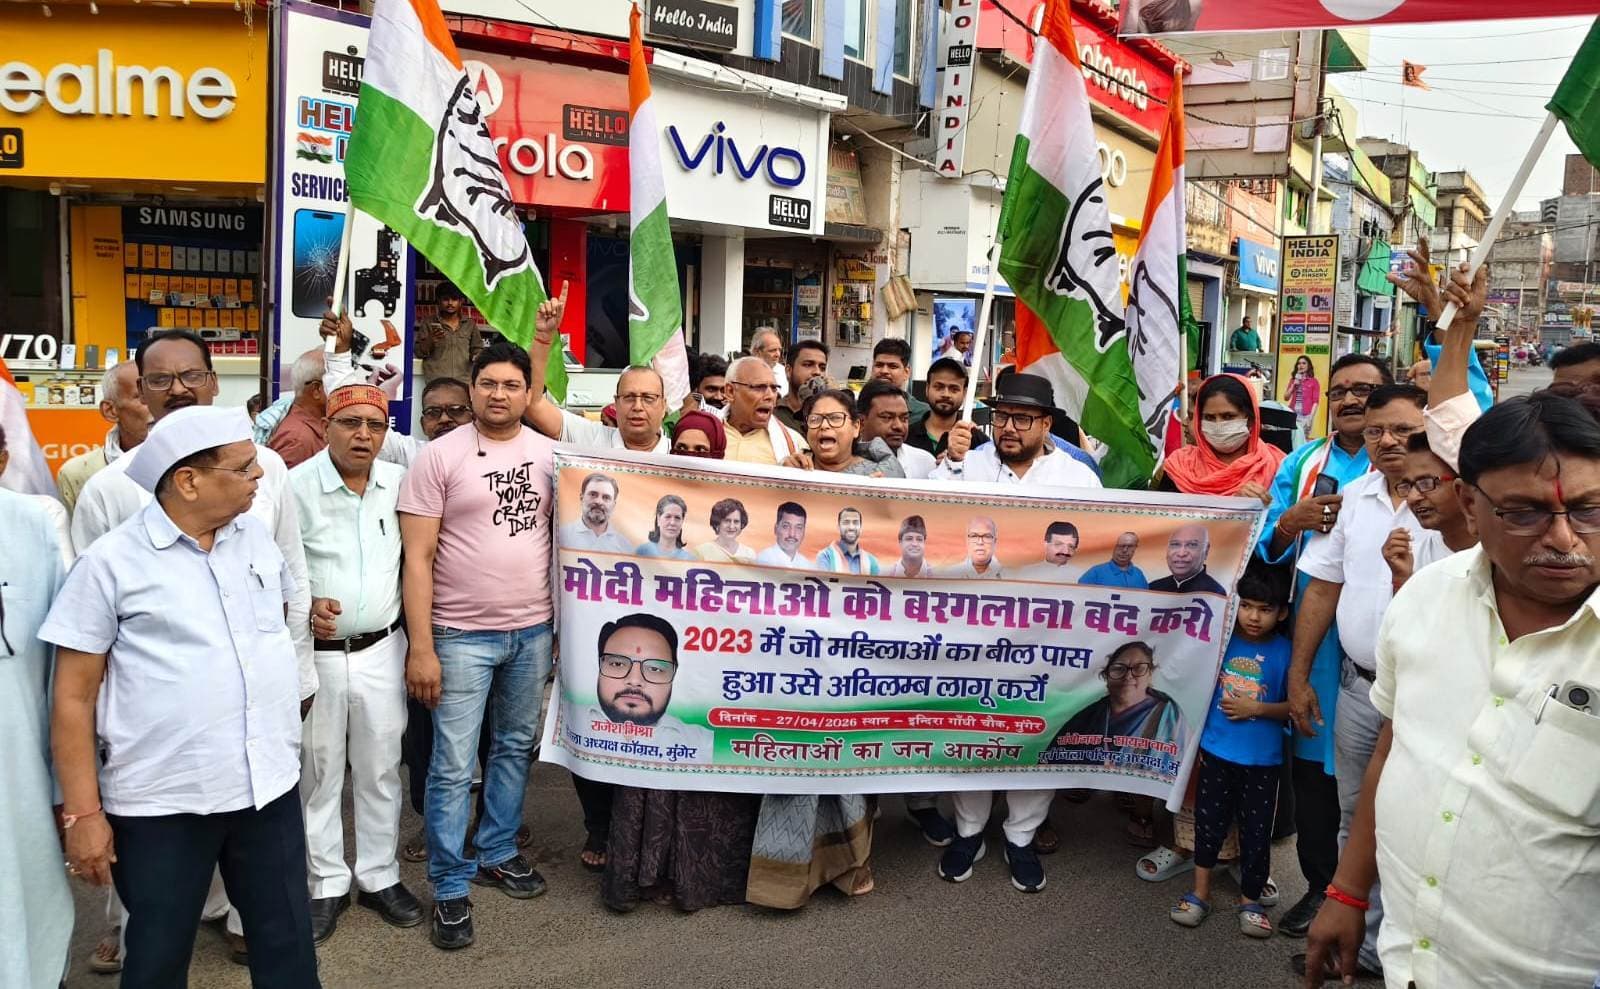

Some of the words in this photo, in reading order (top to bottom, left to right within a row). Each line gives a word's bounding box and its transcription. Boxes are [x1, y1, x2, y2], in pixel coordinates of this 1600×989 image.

[655, 5, 694, 28] Hello
[697, 13, 733, 36] India
[951, 47, 971, 58] HELLO
[328, 58, 363, 82] HELL
[1079, 42, 1148, 112] otorola
[0, 48, 237, 120] ealme
[299, 97, 354, 134] HEL
[569, 110, 626, 134] HELLO
[939, 73, 963, 172] INDIA
[665, 121, 806, 188] vivo
[139, 206, 246, 231] SAMSUNG
[773, 199, 808, 220] HELLO
[1288, 238, 1334, 249] HELLO
[1290, 249, 1330, 258] INDIA
[481, 462, 534, 491] TRUST
[496, 483, 539, 506] YOUR
[493, 496, 541, 526] CRAZY
[507, 514, 537, 537] IDEA
[563, 558, 644, 606] मोदी
[654, 566, 839, 618] महिलाओं
[842, 580, 892, 621] को
[903, 589, 1075, 630] बरगलाना
[1084, 594, 1140, 637] बंद
[1150, 598, 1215, 642] करो
[683, 626, 754, 654] 2023
[760, 626, 787, 656] में
[789, 629, 823, 658] जो
[828, 630, 942, 662] महिलाओं
[945, 641, 980, 662] का
[985, 637, 1037, 665] बील
[1041, 646, 1093, 669] पास
[722, 669, 776, 700] हुआ
[780, 667, 822, 697] उसे
[826, 667, 933, 698] अविलम्ब
[936, 676, 994, 708] लागू
[997, 673, 1050, 703] करों
[591, 719, 623, 737] राजेश
[623, 720, 654, 738] मिश्रा
[719, 711, 757, 724] दिनांक
[776, 714, 857, 728] 27/04/2026
[862, 716, 890, 727] स्थान
[1014, 720, 1043, 733] मुंगेर
[583, 736, 619, 752] अध्यक्ष
[666, 743, 698, 762] मुंगेर
[731, 734, 844, 762] महिलाओं
[852, 739, 882, 761] का
[892, 741, 934, 760] जन
